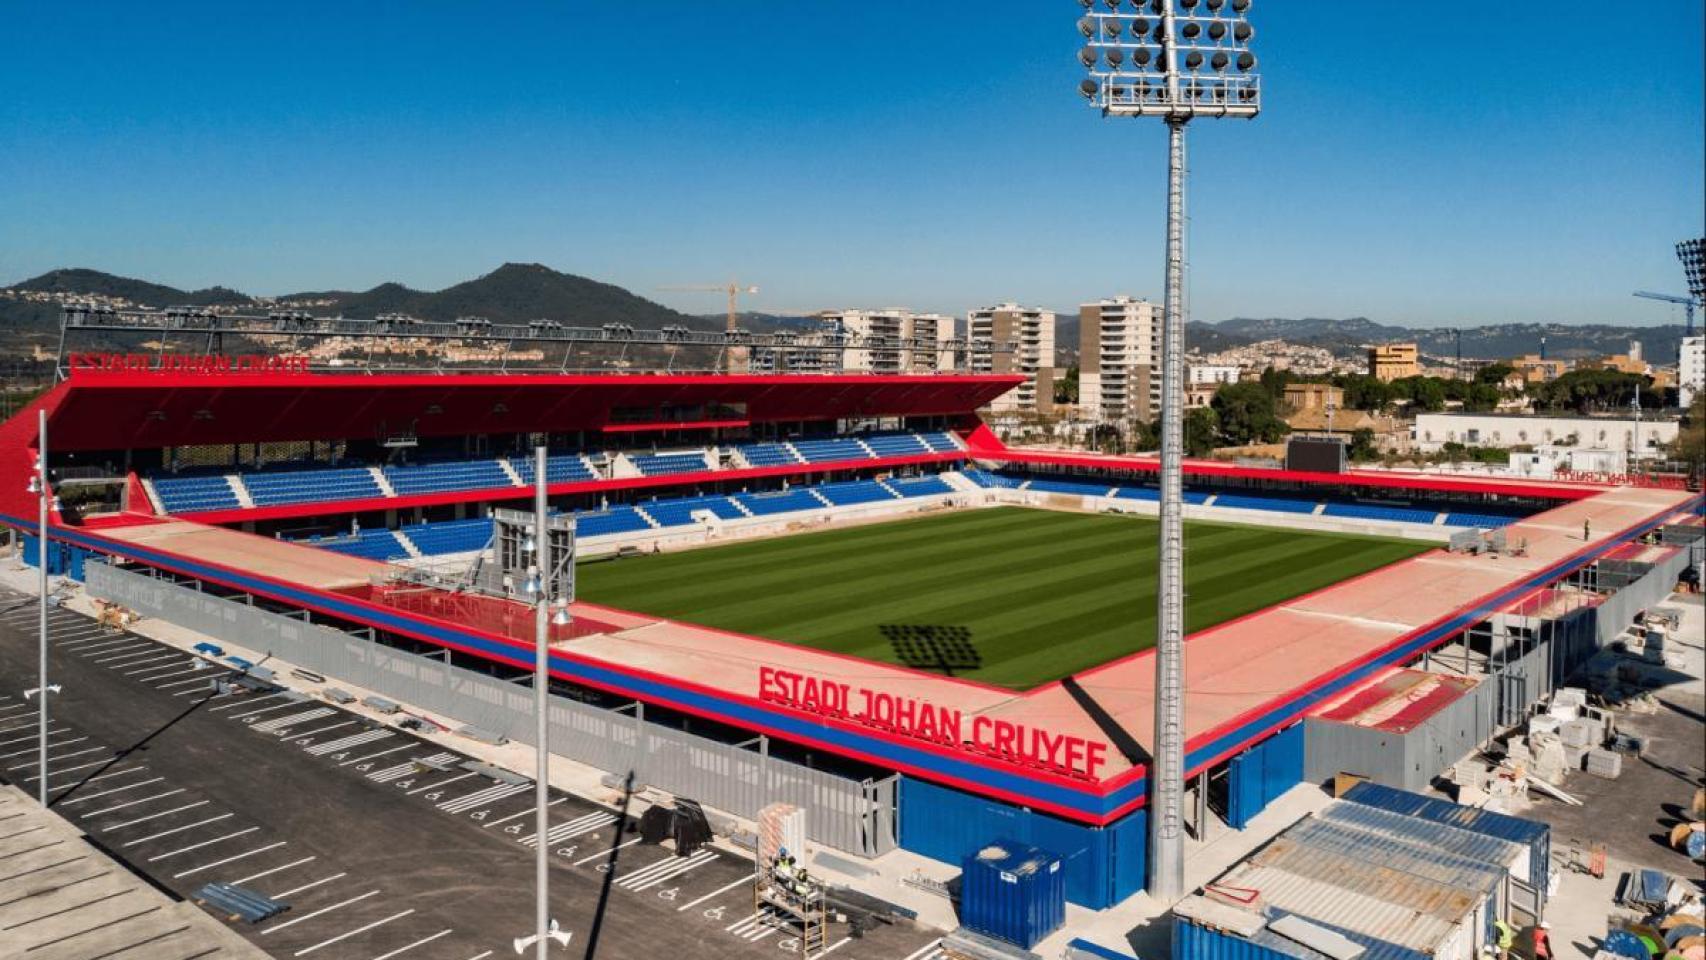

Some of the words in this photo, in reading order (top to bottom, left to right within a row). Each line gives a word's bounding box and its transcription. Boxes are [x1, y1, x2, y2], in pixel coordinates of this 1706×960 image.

[759, 666, 850, 716] ESTADI
[859, 689, 961, 746] JOHAN
[973, 716, 1107, 780] CRUYFF
